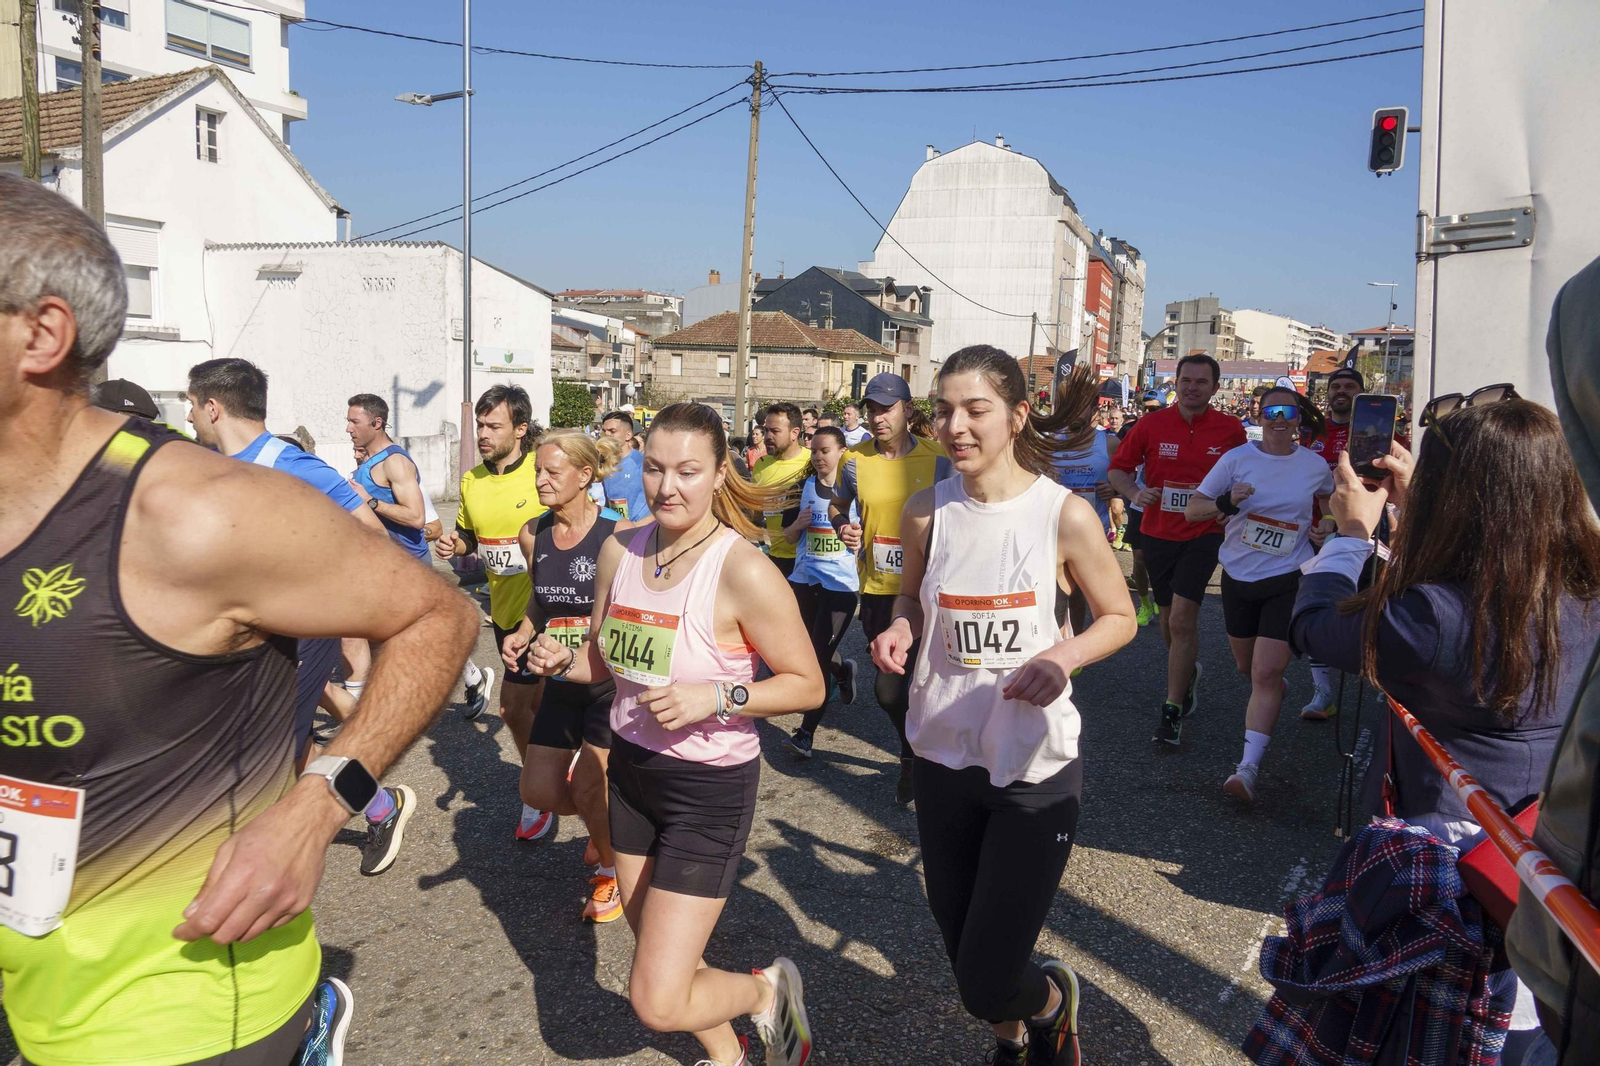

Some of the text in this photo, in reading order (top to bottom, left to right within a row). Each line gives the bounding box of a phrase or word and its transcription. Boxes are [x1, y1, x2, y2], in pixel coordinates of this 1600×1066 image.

[1171, 493, 1194, 507] 60
[814, 538, 840, 552] 2155
[1254, 527, 1284, 549] 720
[486, 550, 514, 568] 842
[954, 620, 1022, 653] 1042
[609, 628, 655, 671] 2144
[0, 715, 85, 748] SIO
